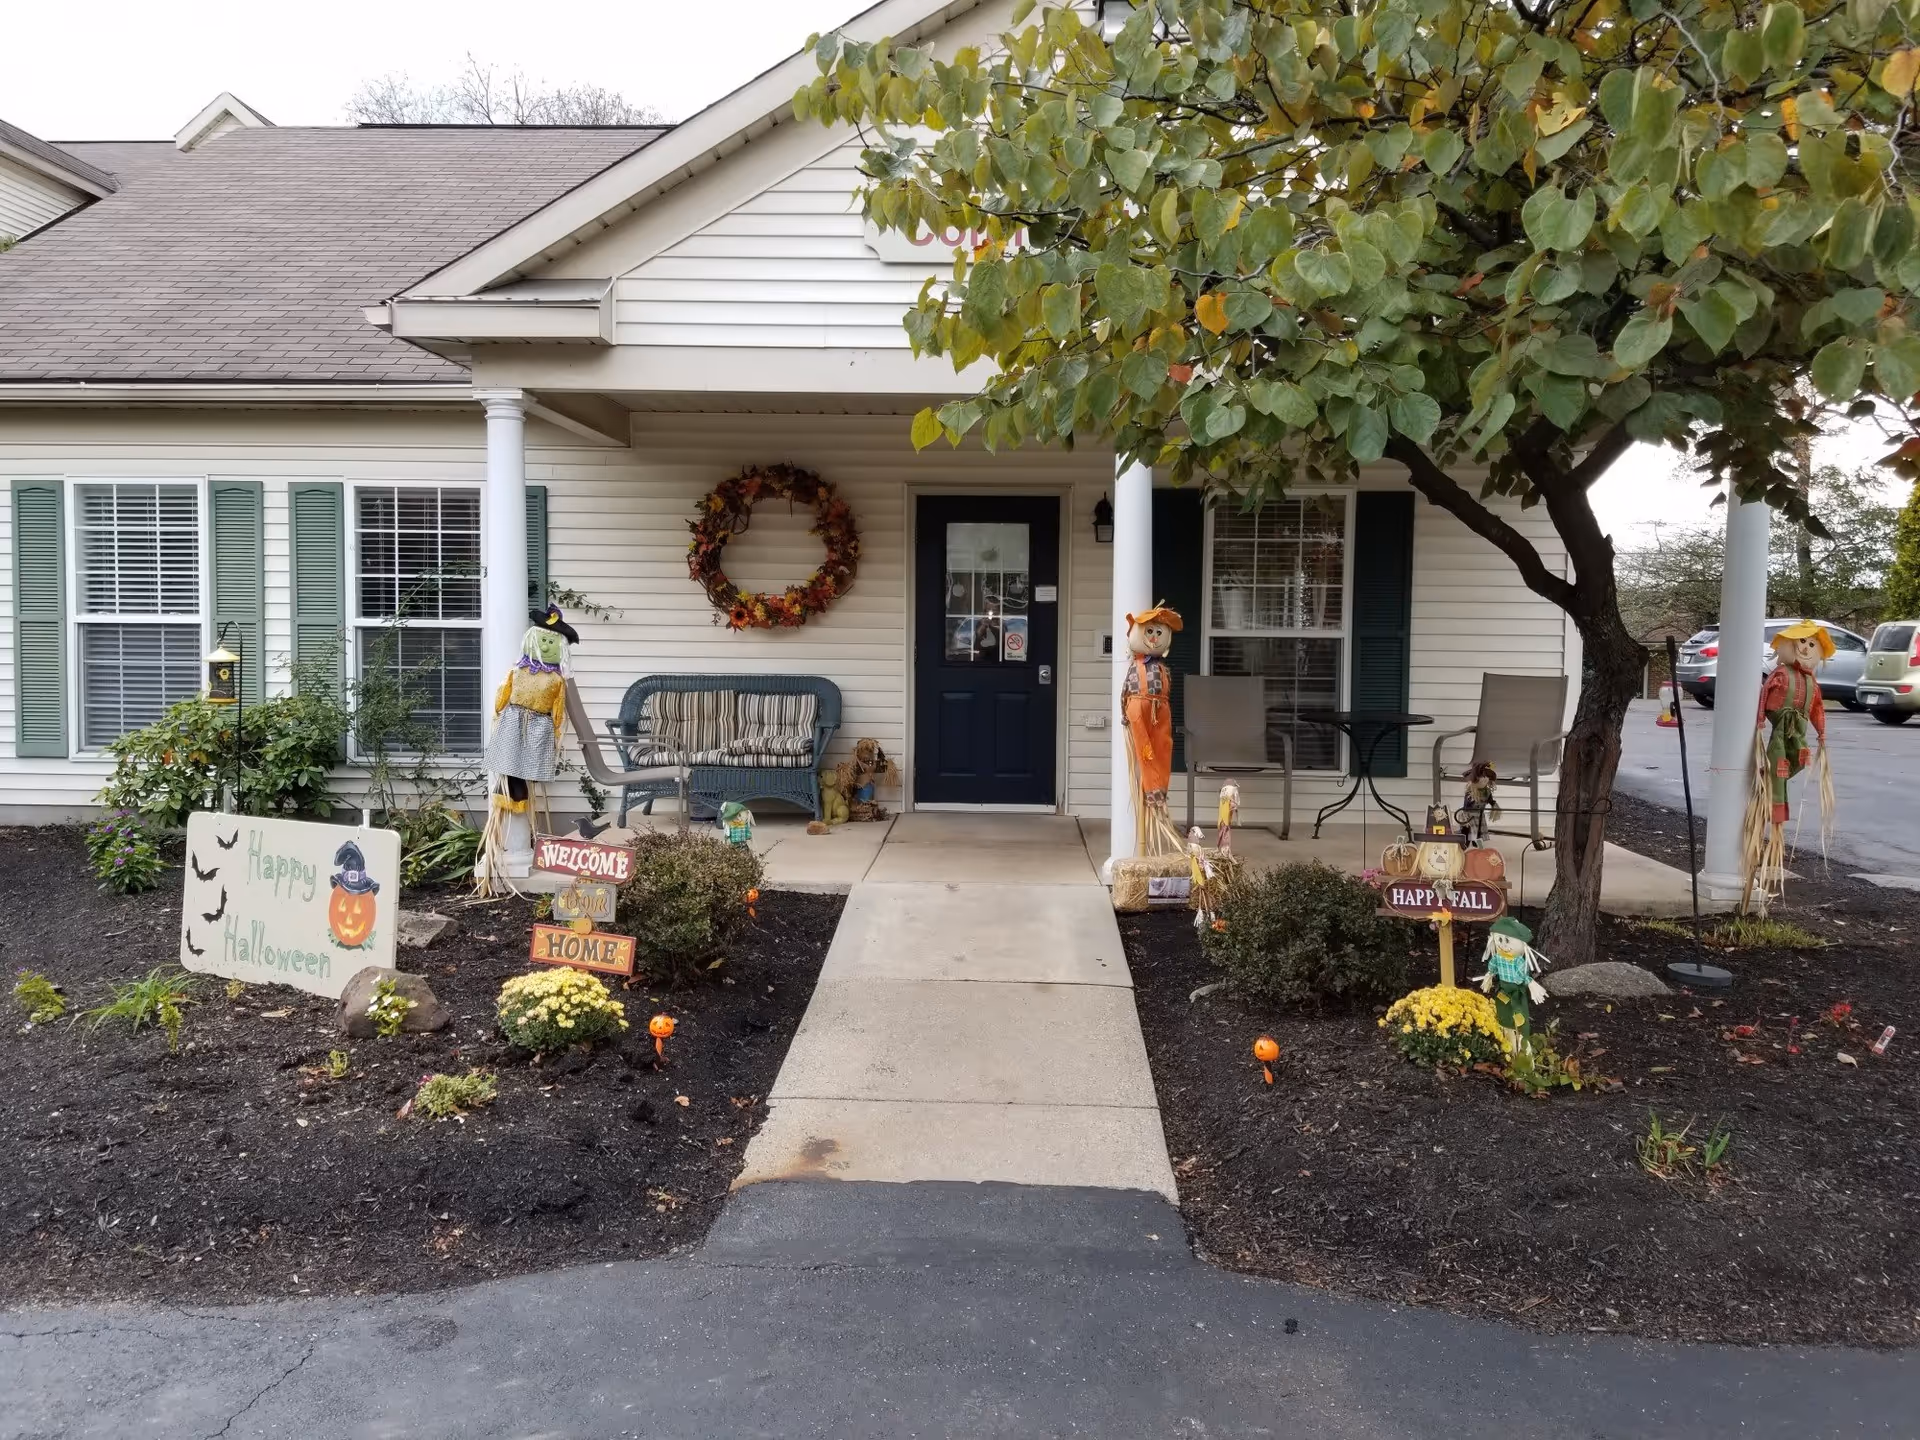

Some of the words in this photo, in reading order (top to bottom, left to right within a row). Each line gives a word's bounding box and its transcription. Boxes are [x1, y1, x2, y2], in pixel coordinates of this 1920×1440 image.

[248, 830, 317, 902] Happy
[541, 844, 628, 879] WELCOME
[1452, 891, 1492, 909] FALL
[224, 914, 330, 978] Halloween
[546, 933, 618, 964] HOME
